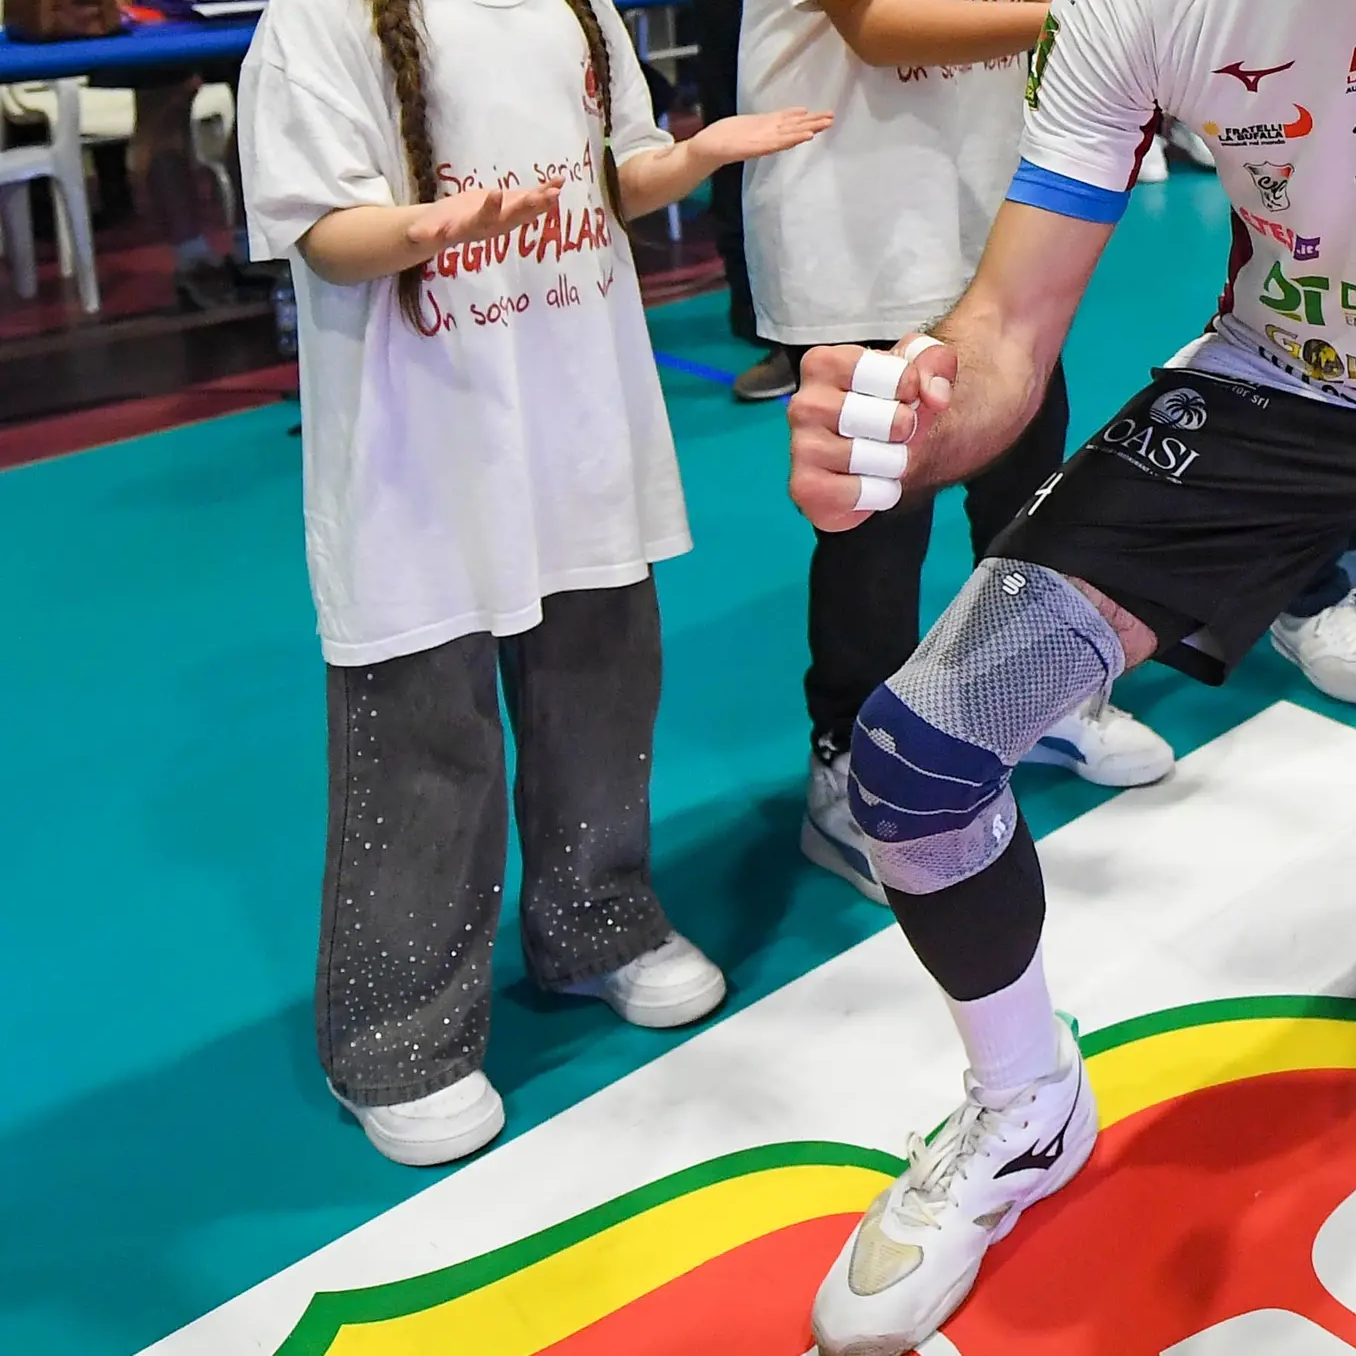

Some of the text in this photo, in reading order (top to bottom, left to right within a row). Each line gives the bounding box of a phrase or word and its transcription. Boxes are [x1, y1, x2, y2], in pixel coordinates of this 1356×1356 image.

[1225, 123, 1283, 136] FRATELLI
[1237, 131, 1284, 141] BUFALA
[423, 228, 511, 282] EGGIO
[546, 273, 581, 308] alla
[1102, 417, 1201, 479] OASI
